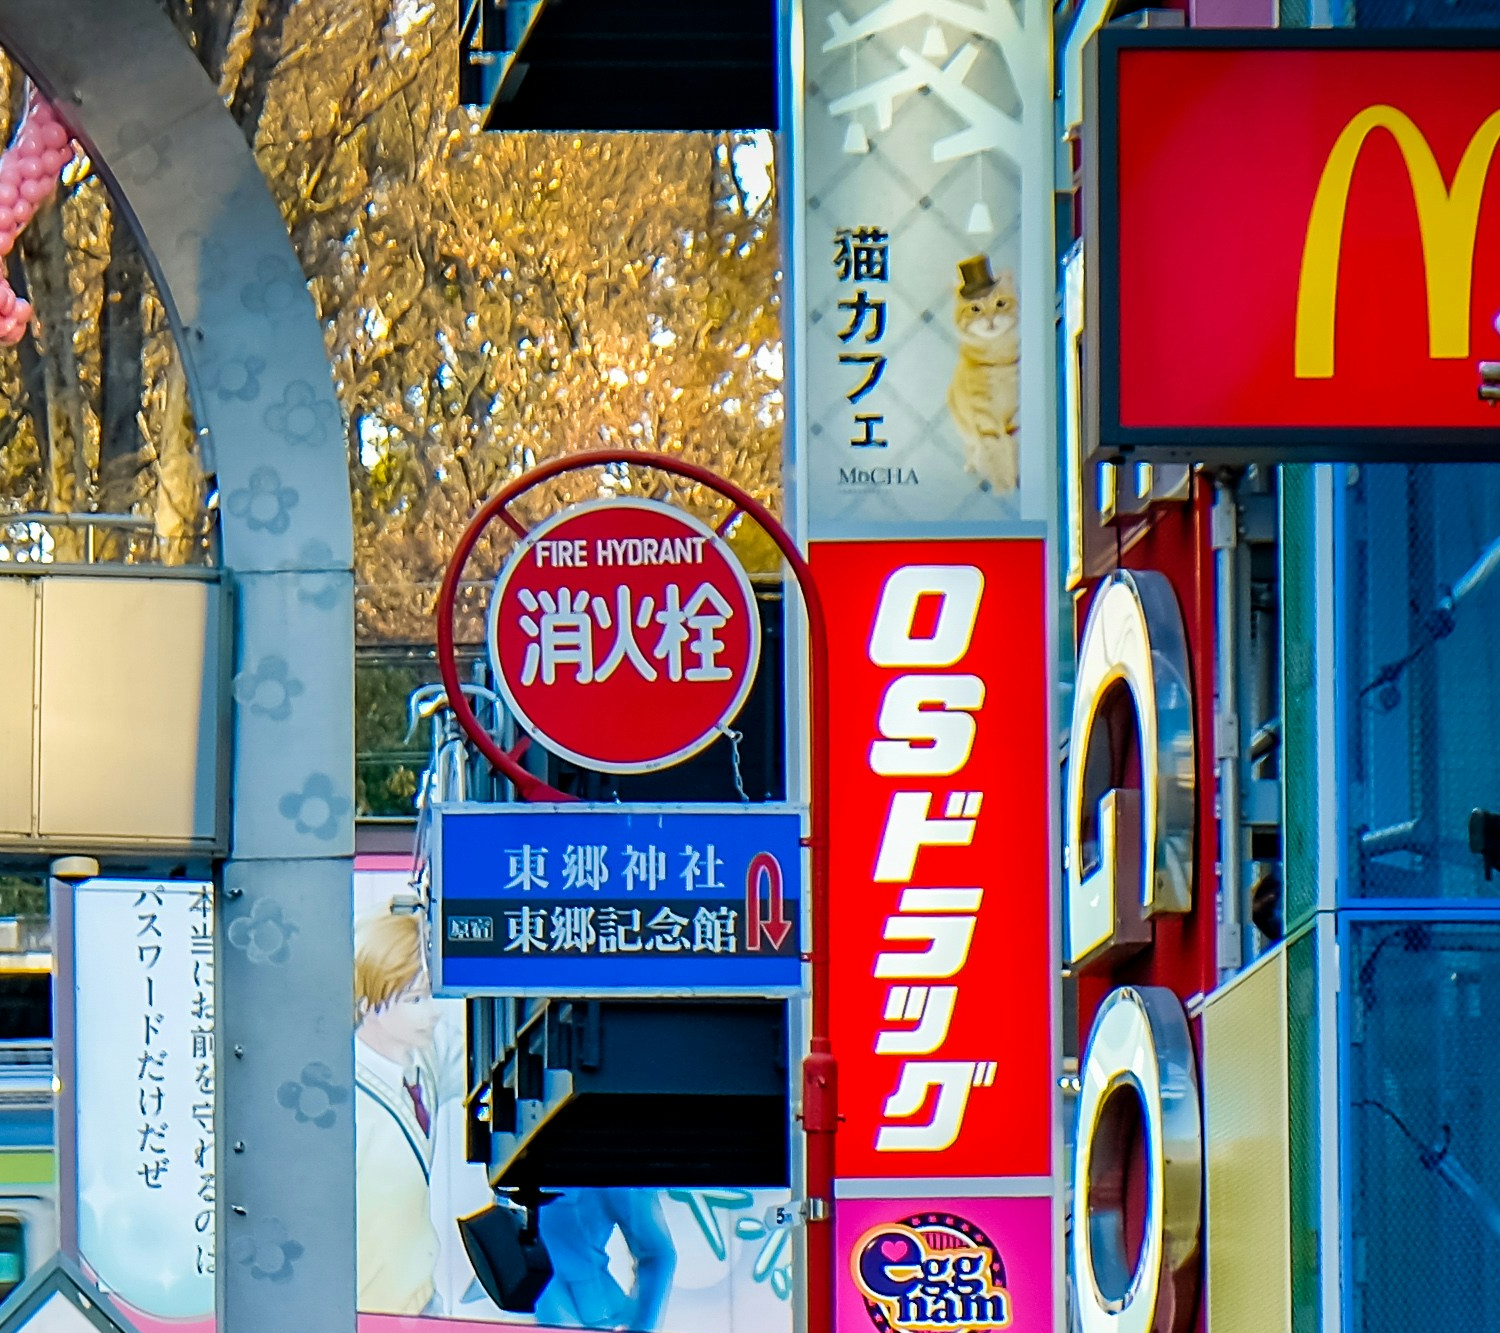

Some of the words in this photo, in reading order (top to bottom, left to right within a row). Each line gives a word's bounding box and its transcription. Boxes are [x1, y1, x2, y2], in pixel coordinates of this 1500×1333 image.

[834, 226, 891, 450] 猫カフェ
[535, 538, 588, 569] FIRE
[596, 536, 706, 569] HYDRANT
[519, 583, 734, 687] 消火栓
[503, 844, 727, 892] 東郷神社
[869, 565, 997, 1152] OSドラッグ
[503, 906, 738, 953] 東郷記念館
[132, 883, 170, 1191] パスワードだけだぜ
